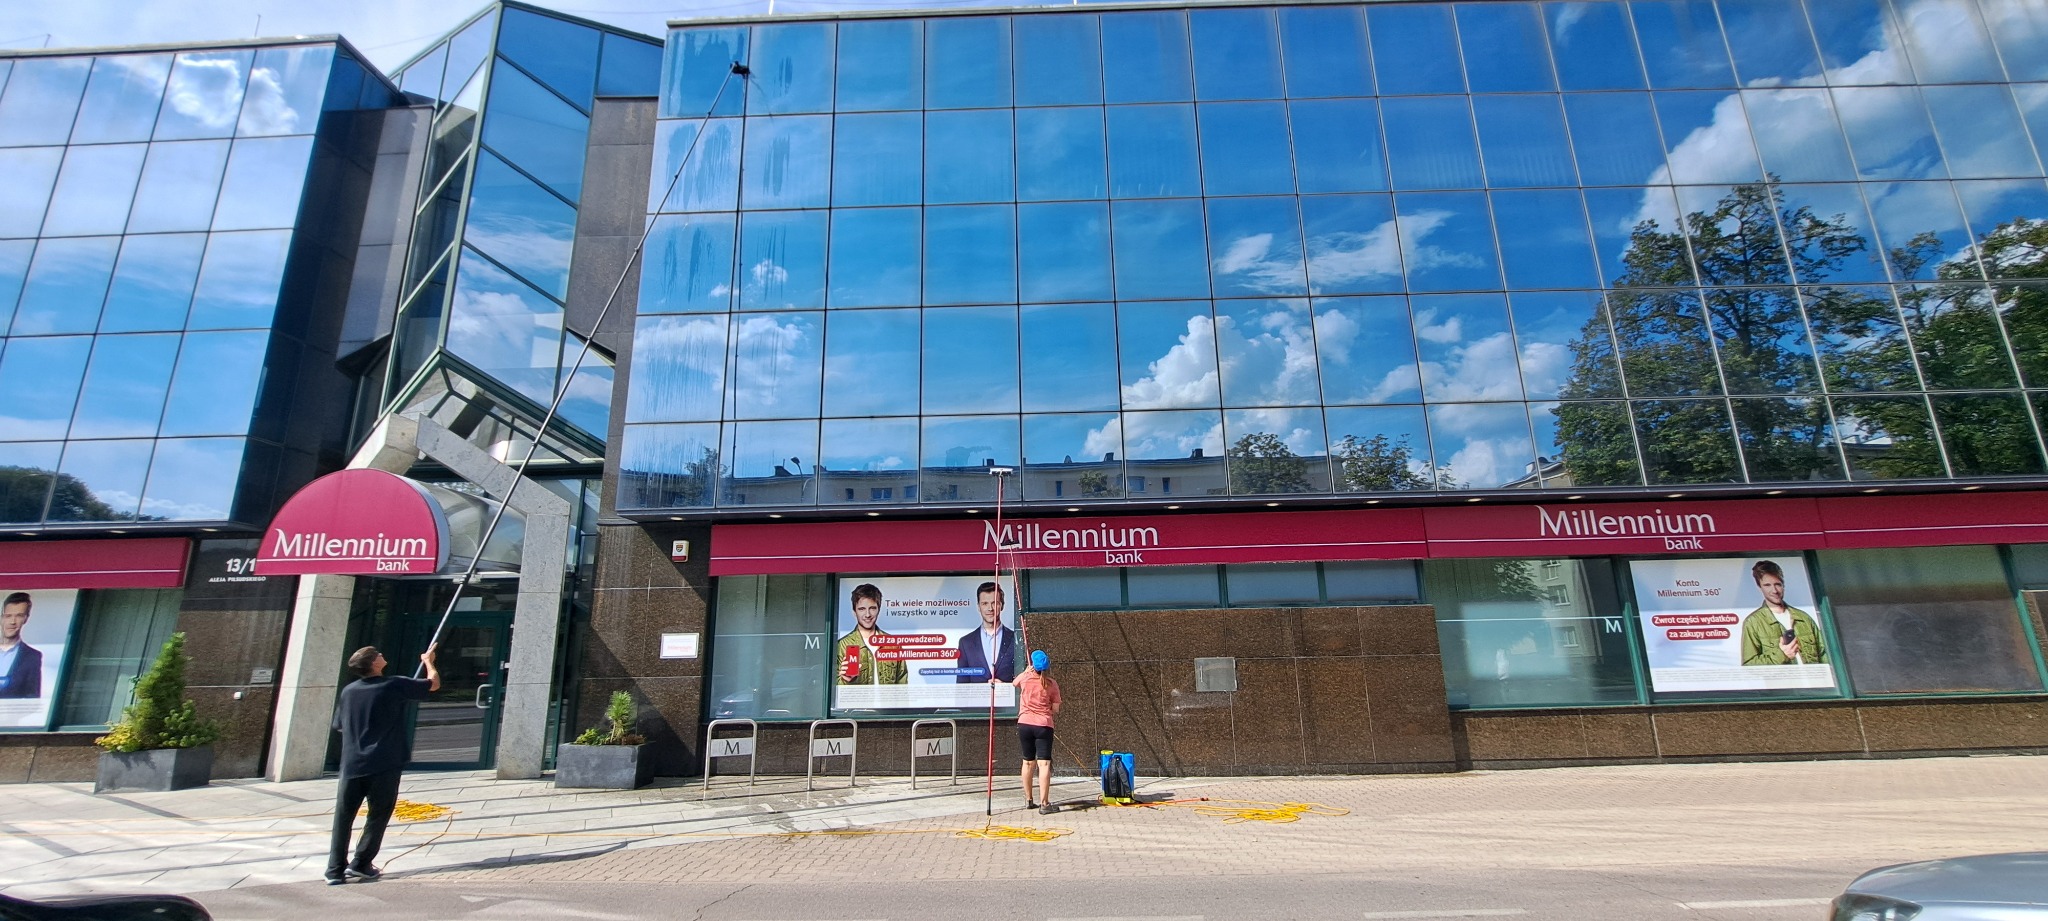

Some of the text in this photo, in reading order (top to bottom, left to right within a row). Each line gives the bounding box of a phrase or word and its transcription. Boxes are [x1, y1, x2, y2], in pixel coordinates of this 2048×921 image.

[1533, 505, 1716, 536] Millennium
[983, 520, 1159, 550] Millennium
[272, 528, 427, 558] Millennium
[1664, 536, 1704, 550] bank
[1105, 550, 1144, 564] bank
[376, 558, 410, 571] bank
[1657, 589, 1702, 597] Millennium
[925, 598, 970, 607] możliwości
[891, 608, 928, 618] wszystko
[939, 609, 959, 618] apce
[1654, 615, 1737, 625] Zwrot części wydatków
[896, 635, 942, 645] prowadzenie
[1679, 630, 1704, 638] zakupy
[1706, 629, 1728, 637] online
[804, 634, 820, 649] M
[849, 655, 857, 663] M
[899, 649, 939, 658] Millennium
[724, 740, 740, 755] M
[826, 740, 841, 755] M
